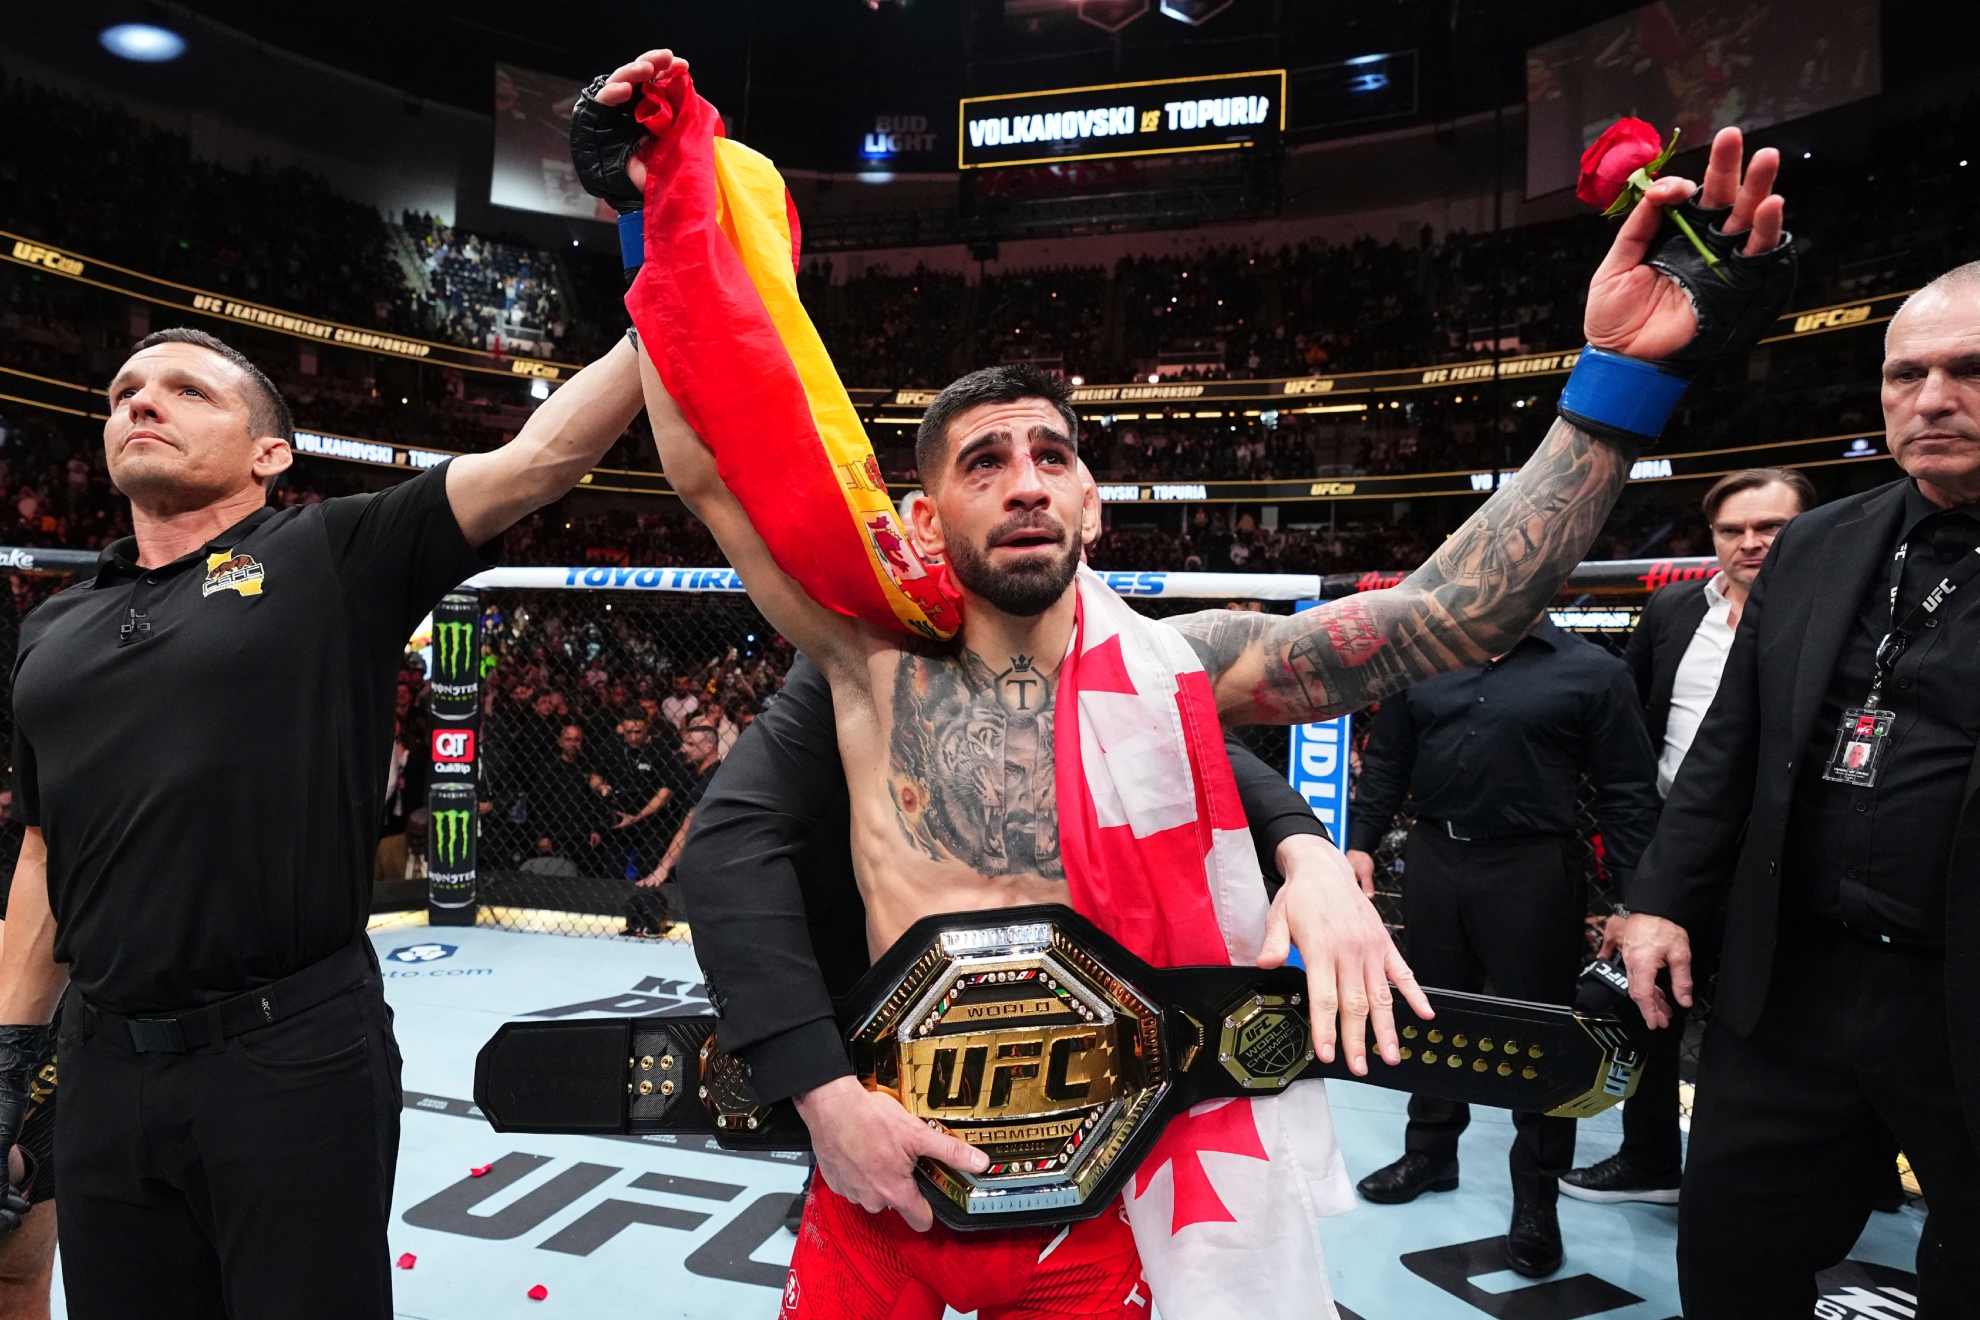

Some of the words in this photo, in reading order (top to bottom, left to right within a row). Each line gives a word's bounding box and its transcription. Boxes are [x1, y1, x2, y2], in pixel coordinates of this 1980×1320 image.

[875, 115, 928, 133] BUD
[969, 106, 1135, 147] VOLKANOVSKI
[1140, 110, 1161, 132] VS
[864, 131, 938, 153] LIGHT
[193, 294, 222, 313] UFC
[224, 301, 333, 339] FEATHERWEIGHT
[334, 327, 430, 357] CHAMPIONSHIP
[1422, 370, 1448, 384] UFC
[1120, 385, 1204, 400] CHAMPIONSHIP
[294, 432, 393, 464] VOLKANOVSKI
[1152, 484, 1207, 500] TOPURIA
[566, 567, 664, 588] TOYO
[1922, 577, 1957, 613] UFC
[431, 682, 478, 696] MONSTER
[1006, 680, 1037, 710] T
[436, 733, 469, 757] QT
[429, 870, 476, 884] MONSTER
[1596, 962, 1628, 990] UFC
[967, 1001, 1050, 1018] WORLD
[1245, 1016, 1272, 1043] UFC
[1245, 1020, 1290, 1058] WORLD
[1246, 1022, 1301, 1069] CHAMPION
[927, 1031, 1098, 1111] UFC
[1603, 1047, 1638, 1096] UFC
[965, 1123, 1074, 1142] CHAMPION
[401, 1151, 809, 1289] UFC
